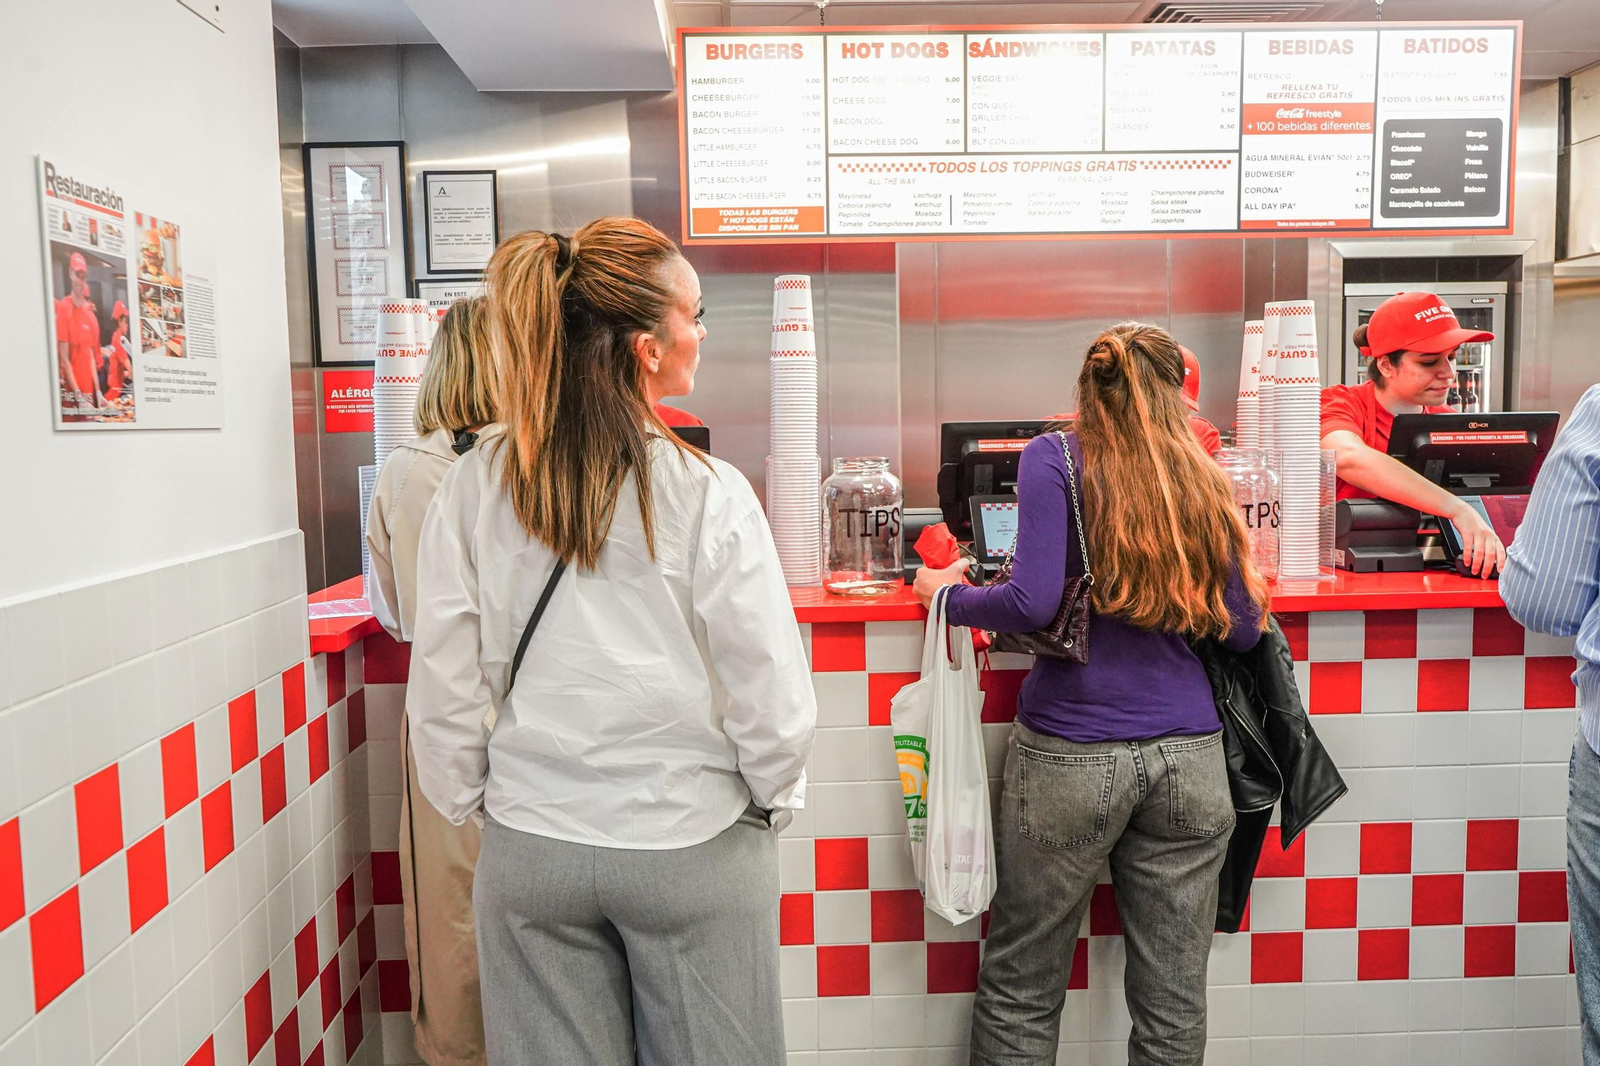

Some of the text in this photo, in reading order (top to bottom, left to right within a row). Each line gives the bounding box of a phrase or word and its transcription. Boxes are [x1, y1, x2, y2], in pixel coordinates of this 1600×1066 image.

[706, 43, 803, 60] BURGERS
[842, 42, 949, 58] HOT DOGS
[1131, 41, 1216, 56] PATATAS
[1269, 39, 1354, 55] BEBIDAS
[1404, 38, 1488, 54] BATIDOS
[692, 94, 760, 102] CHEESEBURGER
[1306, 110, 1342, 119] freestyle
[1256, 121, 1371, 131] 100 bebidas diferentes
[928, 160, 1137, 173] TODOS LOS TOPPINGS GRATIS
[44, 161, 124, 212] Restauración
[1415, 306, 1439, 321] FIVE
[1280, 351, 1307, 359] GUYS
[839, 506, 900, 538] TIPS
[1242, 501, 1280, 528] IPS
[895, 740, 922, 748] TILITZABLE
